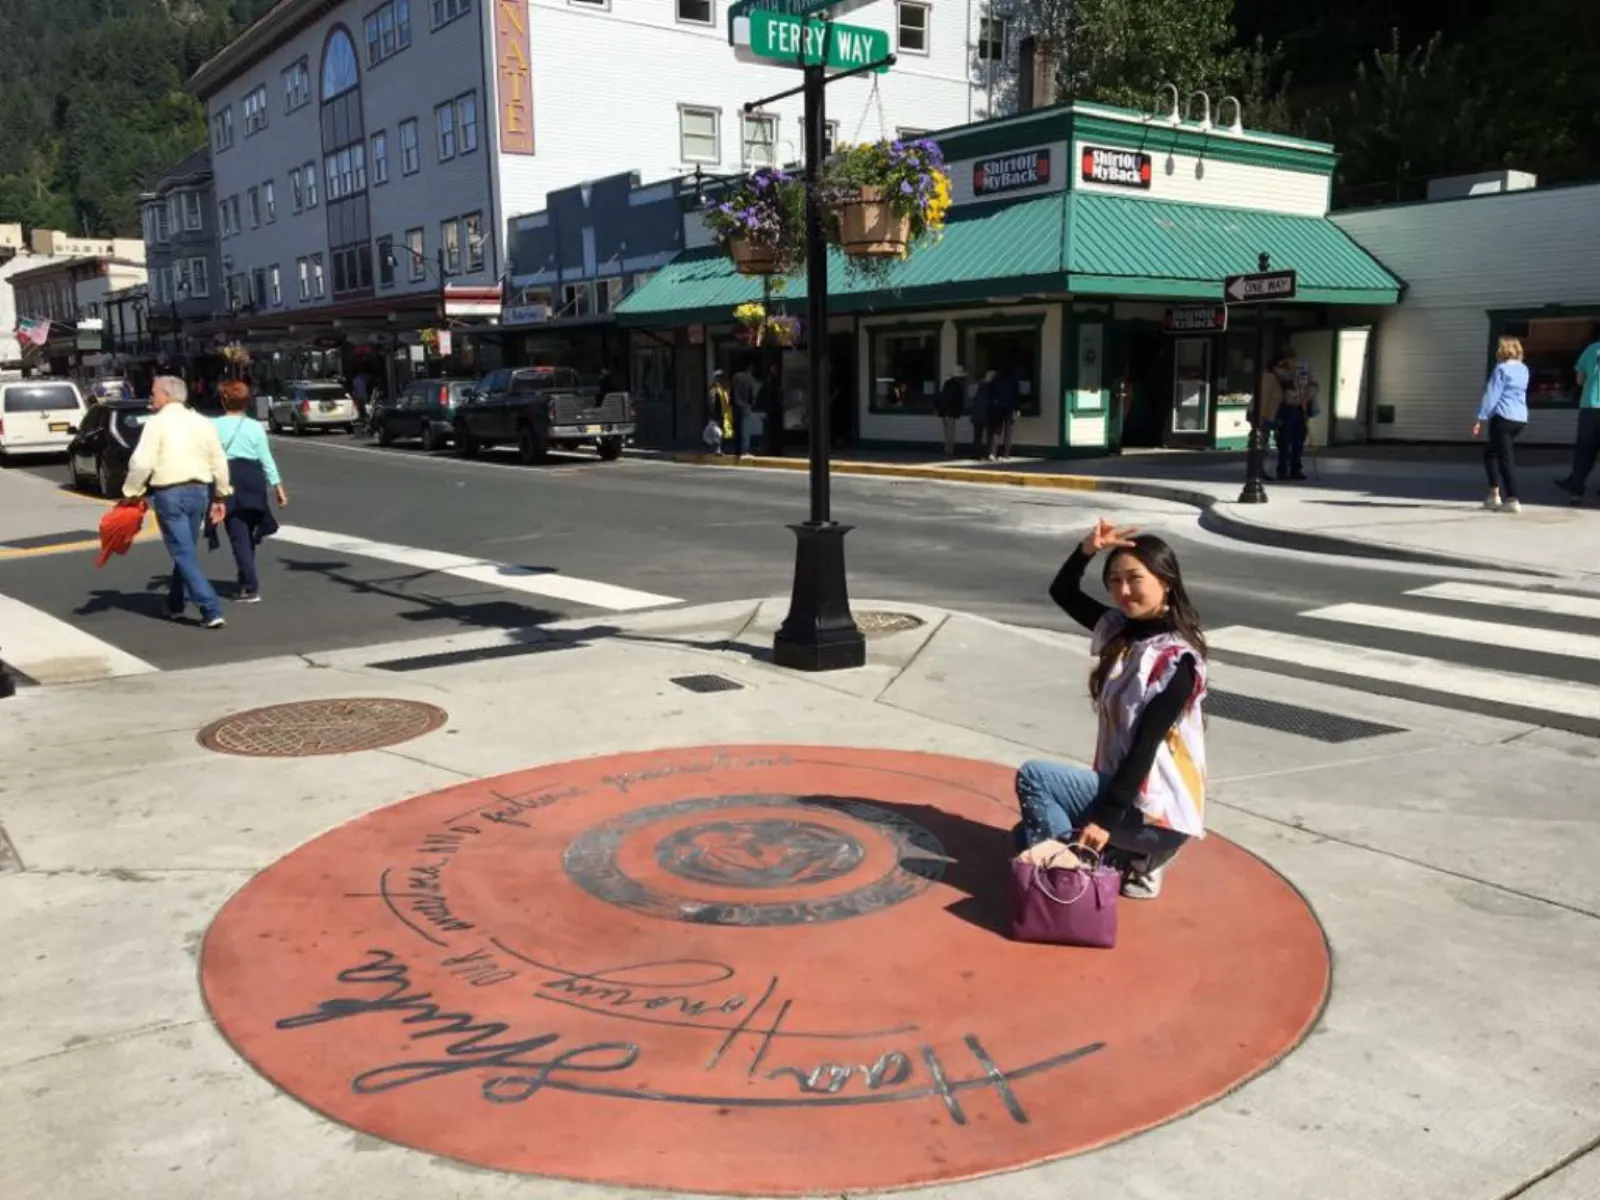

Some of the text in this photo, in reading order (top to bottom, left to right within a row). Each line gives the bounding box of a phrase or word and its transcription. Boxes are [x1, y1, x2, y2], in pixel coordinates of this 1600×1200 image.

[768, 20, 873, 64] FERRY WAY
[1092, 165, 1142, 184] MyBack
[1245, 279, 1288, 294] ONE WAY
